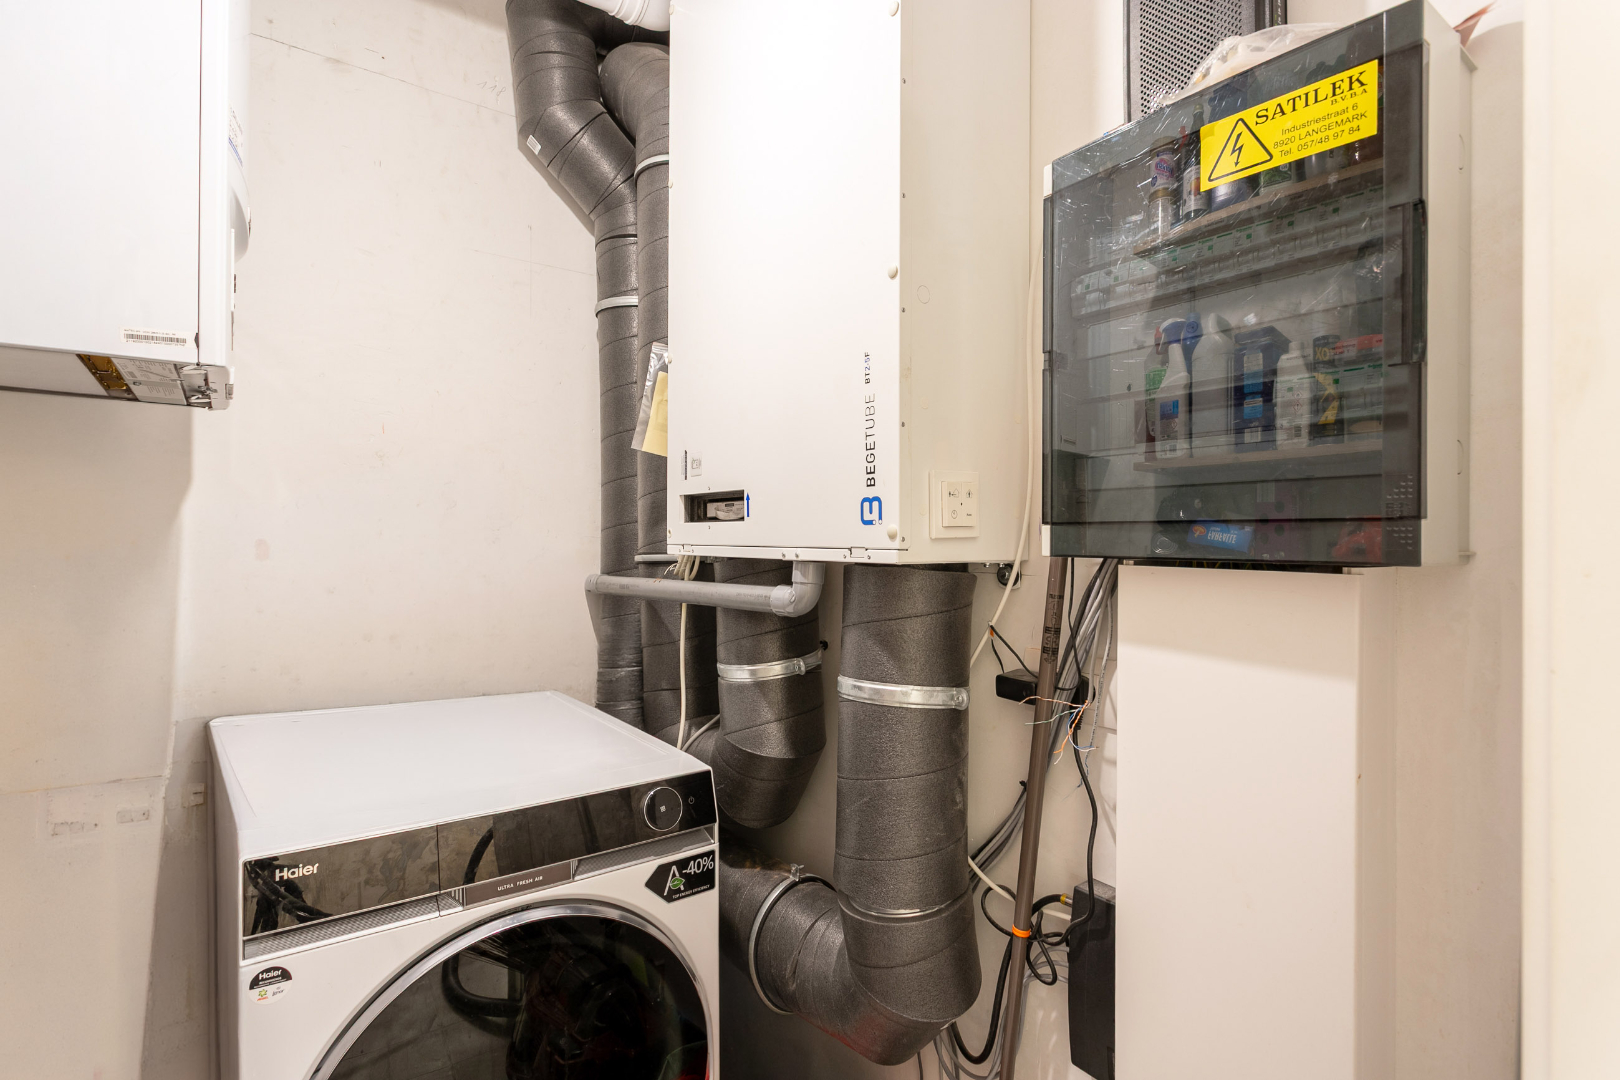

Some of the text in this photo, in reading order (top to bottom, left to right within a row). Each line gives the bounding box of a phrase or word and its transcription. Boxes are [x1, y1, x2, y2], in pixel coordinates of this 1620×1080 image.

[1256, 71, 1368, 126] SATILEK
[1272, 111, 1368, 149] 8920 LANGEMARK
[1282, 103, 1359, 135] Industriestraat 6
[1279, 125, 1361, 157] Tel. 057/48 97 84
[865, 393, 876, 487] BEGETUBE
[275, 863, 319, 881] Haier
[682, 854, 714, 875] -40%
[497, 883, 514, 891] ULTRA
[516, 878, 533, 886] FRESH
[679, 889, 693, 897] ENERGY
[258, 969, 283, 981] Haier
